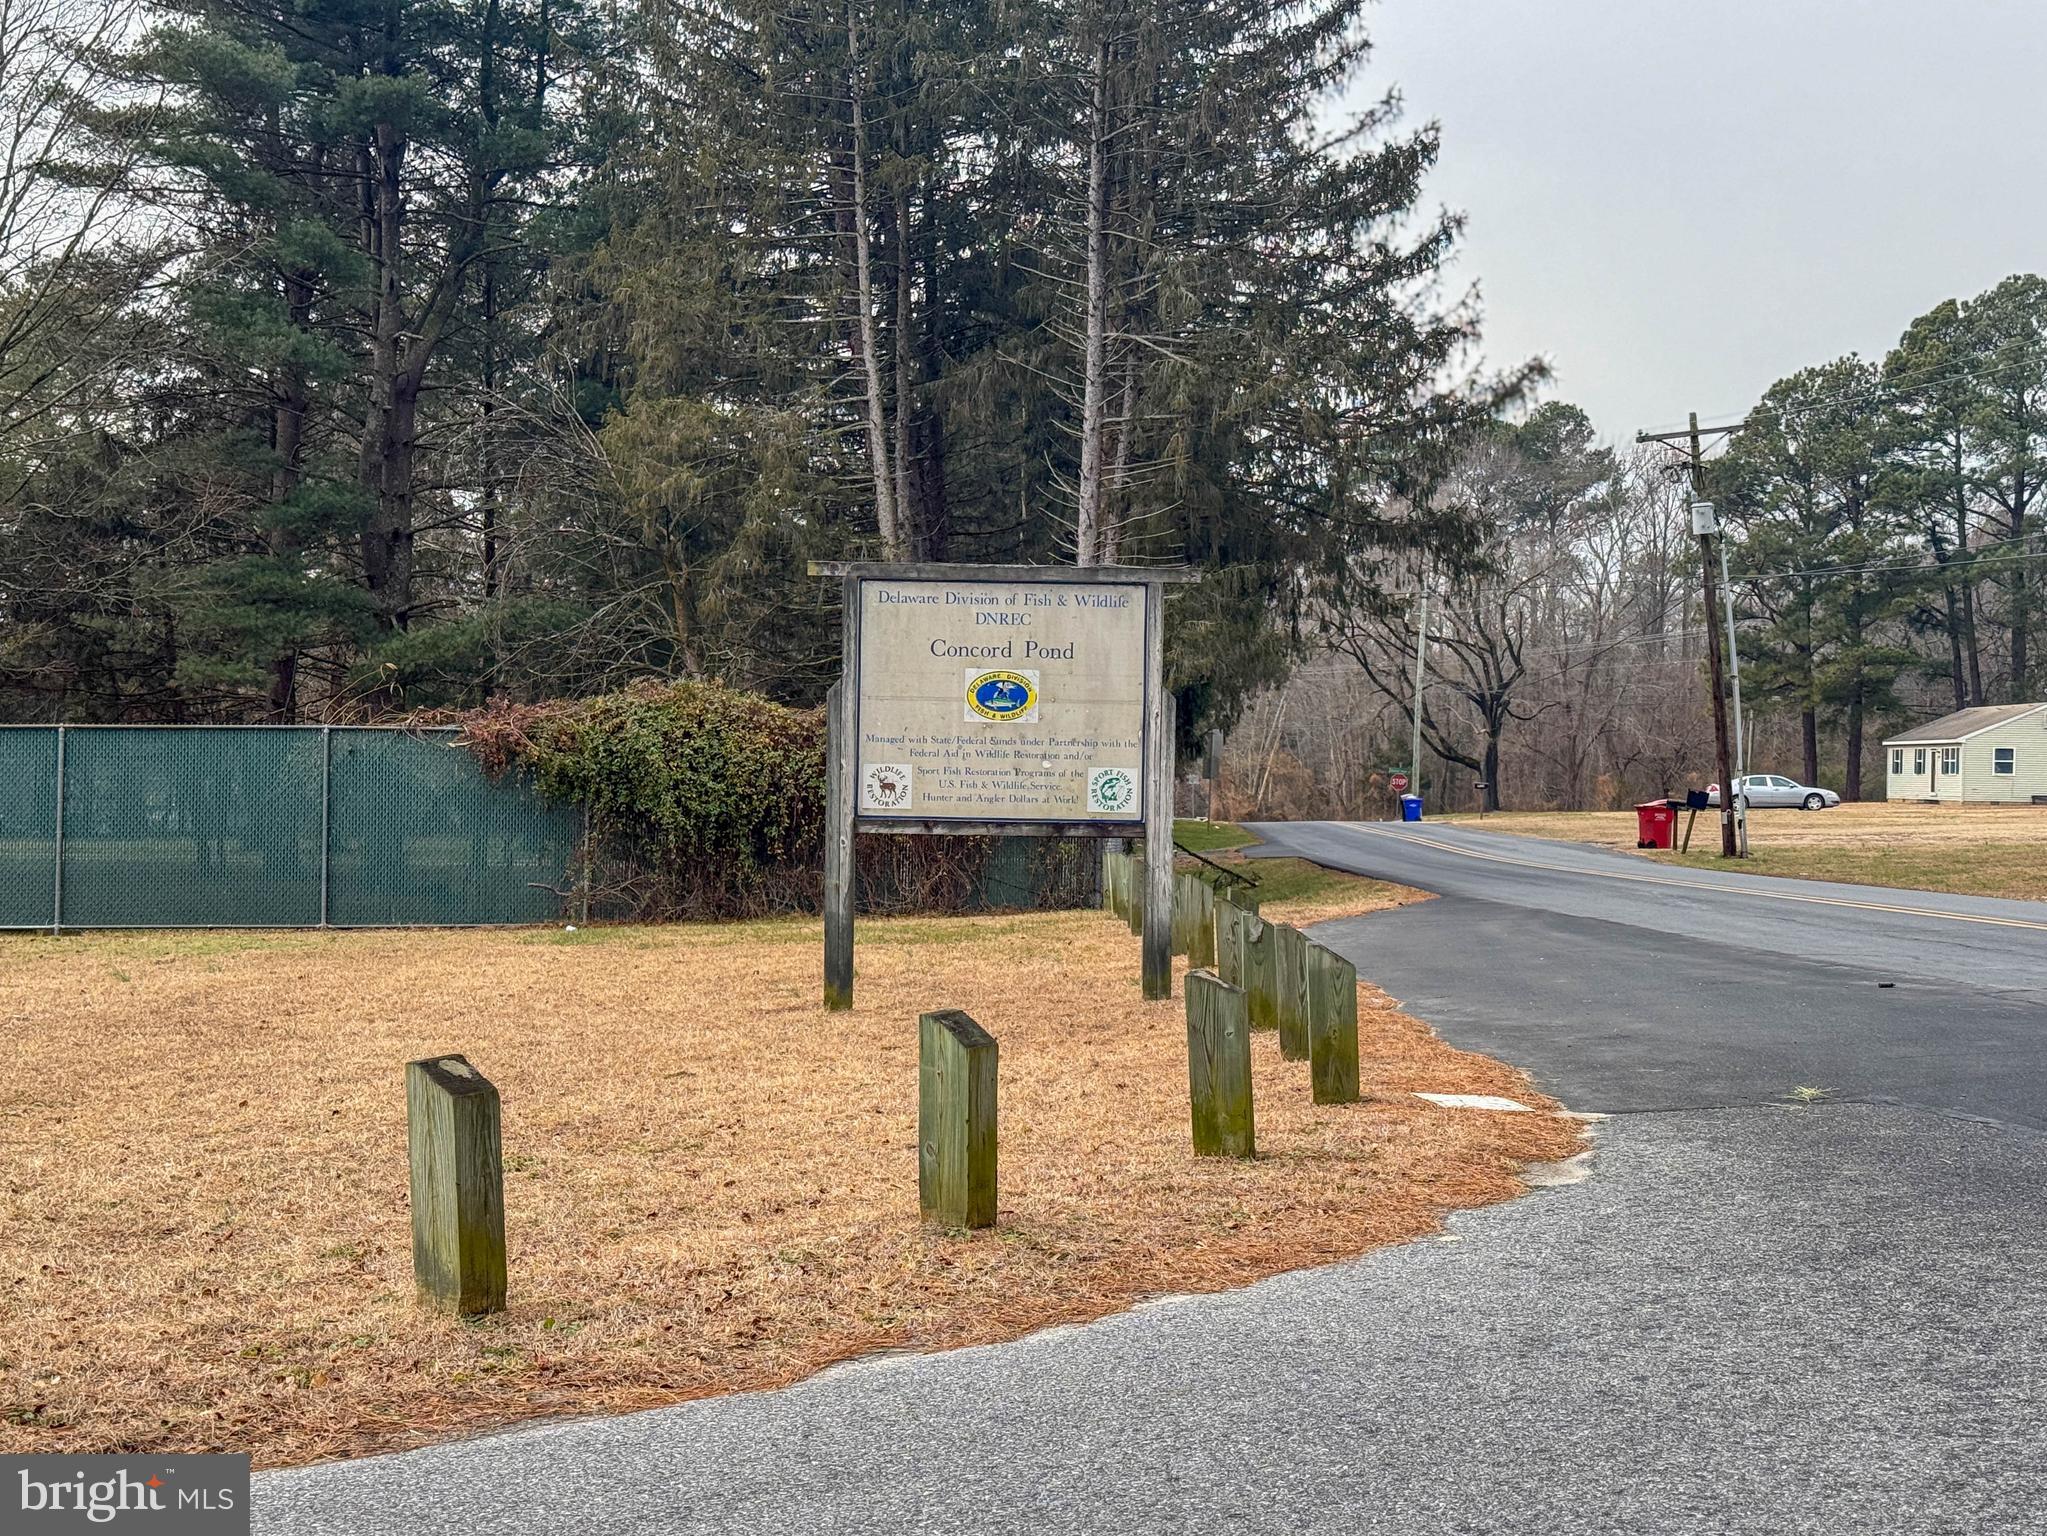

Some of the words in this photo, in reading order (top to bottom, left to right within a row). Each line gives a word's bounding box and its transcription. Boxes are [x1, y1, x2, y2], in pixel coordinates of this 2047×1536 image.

[878, 590, 939, 604] Delaware
[945, 591, 999, 605] Division
[1005, 593, 1018, 606] of
[1023, 593, 1052, 606] Fish
[1057, 594, 1068, 607] &
[1074, 594, 1129, 608] Wildlife
[975, 612, 1032, 626] DNREC
[930, 638, 1012, 659] Concord
[1024, 640, 1074, 660] Pond
[969, 673, 1001, 694] DELAWARE
[1006, 674, 1033, 693] DIVISION
[975, 704, 990, 716] FISH
[865, 734, 905, 745] Managed
[908, 735, 928, 744] with
[930, 735, 987, 745] State/Federal
[1020, 737, 1044, 746] under
[1049, 737, 1098, 749] Partnership
[1101, 739, 1121, 748] with
[1124, 740, 1138, 749] the
[909, 748, 940, 758] Federal
[943, 749, 959, 758] Aid
[975, 749, 1010, 759] Wildlife
[1014, 750, 1060, 760] Restoration
[1063, 751, 1093, 761] and/or
[869, 765, 906, 781] WILDLIFE
[917, 766, 940, 777] Sport
[943, 766, 962, 775] Fish
[964, 766, 1011, 777] Restoration
[1013, 767, 1056, 778] Programs
[1058, 768, 1068, 777] of
[1070, 769, 1084, 778] the
[1091, 769, 1113, 787] SPORT
[1116, 770, 1131, 786] FISH
[938, 779, 957, 789] U.S.
[960, 779, 978, 789] Fish
[981, 780, 989, 789] &
[866, 783, 908, 807] RESTORATION
[922, 792, 954, 802] Hunter
[956, 793, 973, 802] and
[976, 793, 1006, 805] Angler
[1009, 794, 1039, 804] Dollars
[1042, 795, 1050, 804] at
[1090, 788, 1133, 811] RESTORATION
